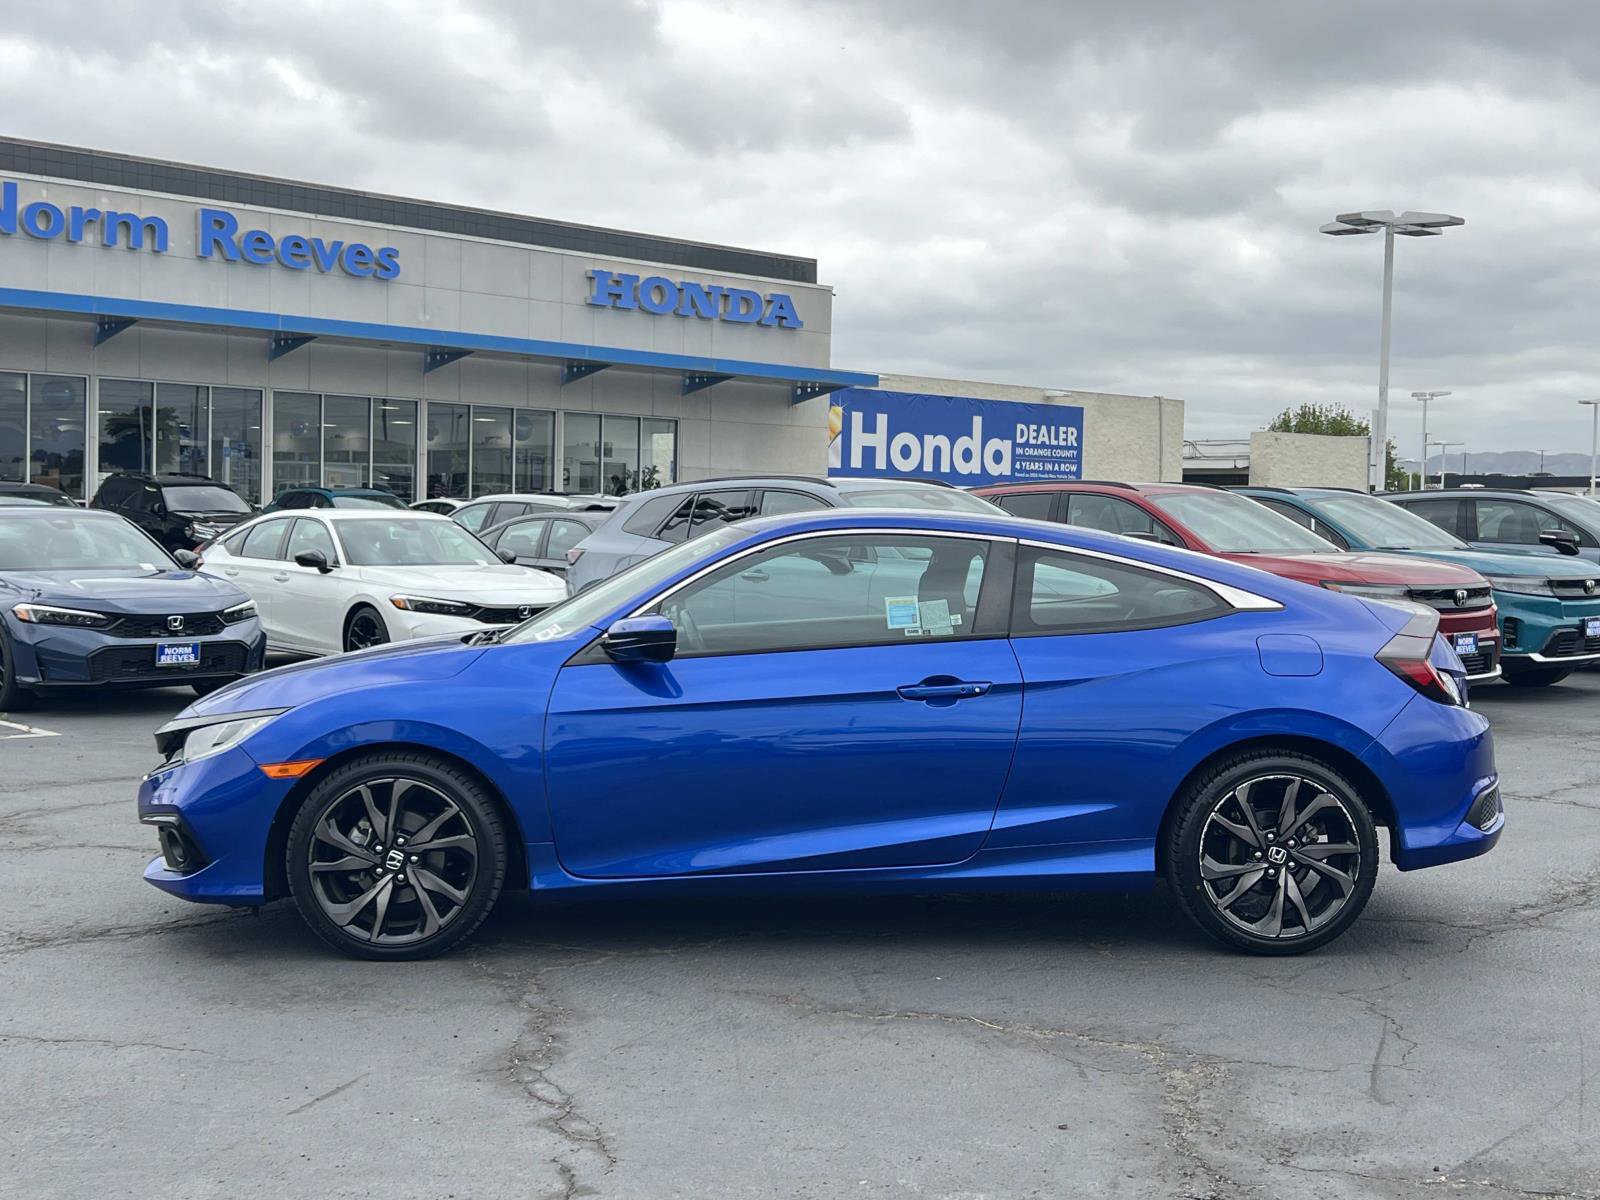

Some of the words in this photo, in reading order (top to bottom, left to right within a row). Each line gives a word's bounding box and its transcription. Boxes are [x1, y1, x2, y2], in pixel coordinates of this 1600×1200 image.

[196, 207, 401, 281] Reeves
[586, 269, 804, 329] HONDA
[1016, 423, 1078, 447] DEALER
[850, 411, 1012, 477] Honda
[1015, 447, 1024, 456] IN
[1024, 447, 1052, 457] ORANGE
[1052, 449, 1078, 458] COUNTY
[1015, 461, 1021, 470] 4
[1021, 461, 1044, 471] YEARS
[1044, 462, 1053, 471] IN
[1053, 463, 1060, 471] A
[1060, 463, 1078, 472] ROW
[160, 654, 195, 662] REEVES
[164, 646, 193, 655] NORM
